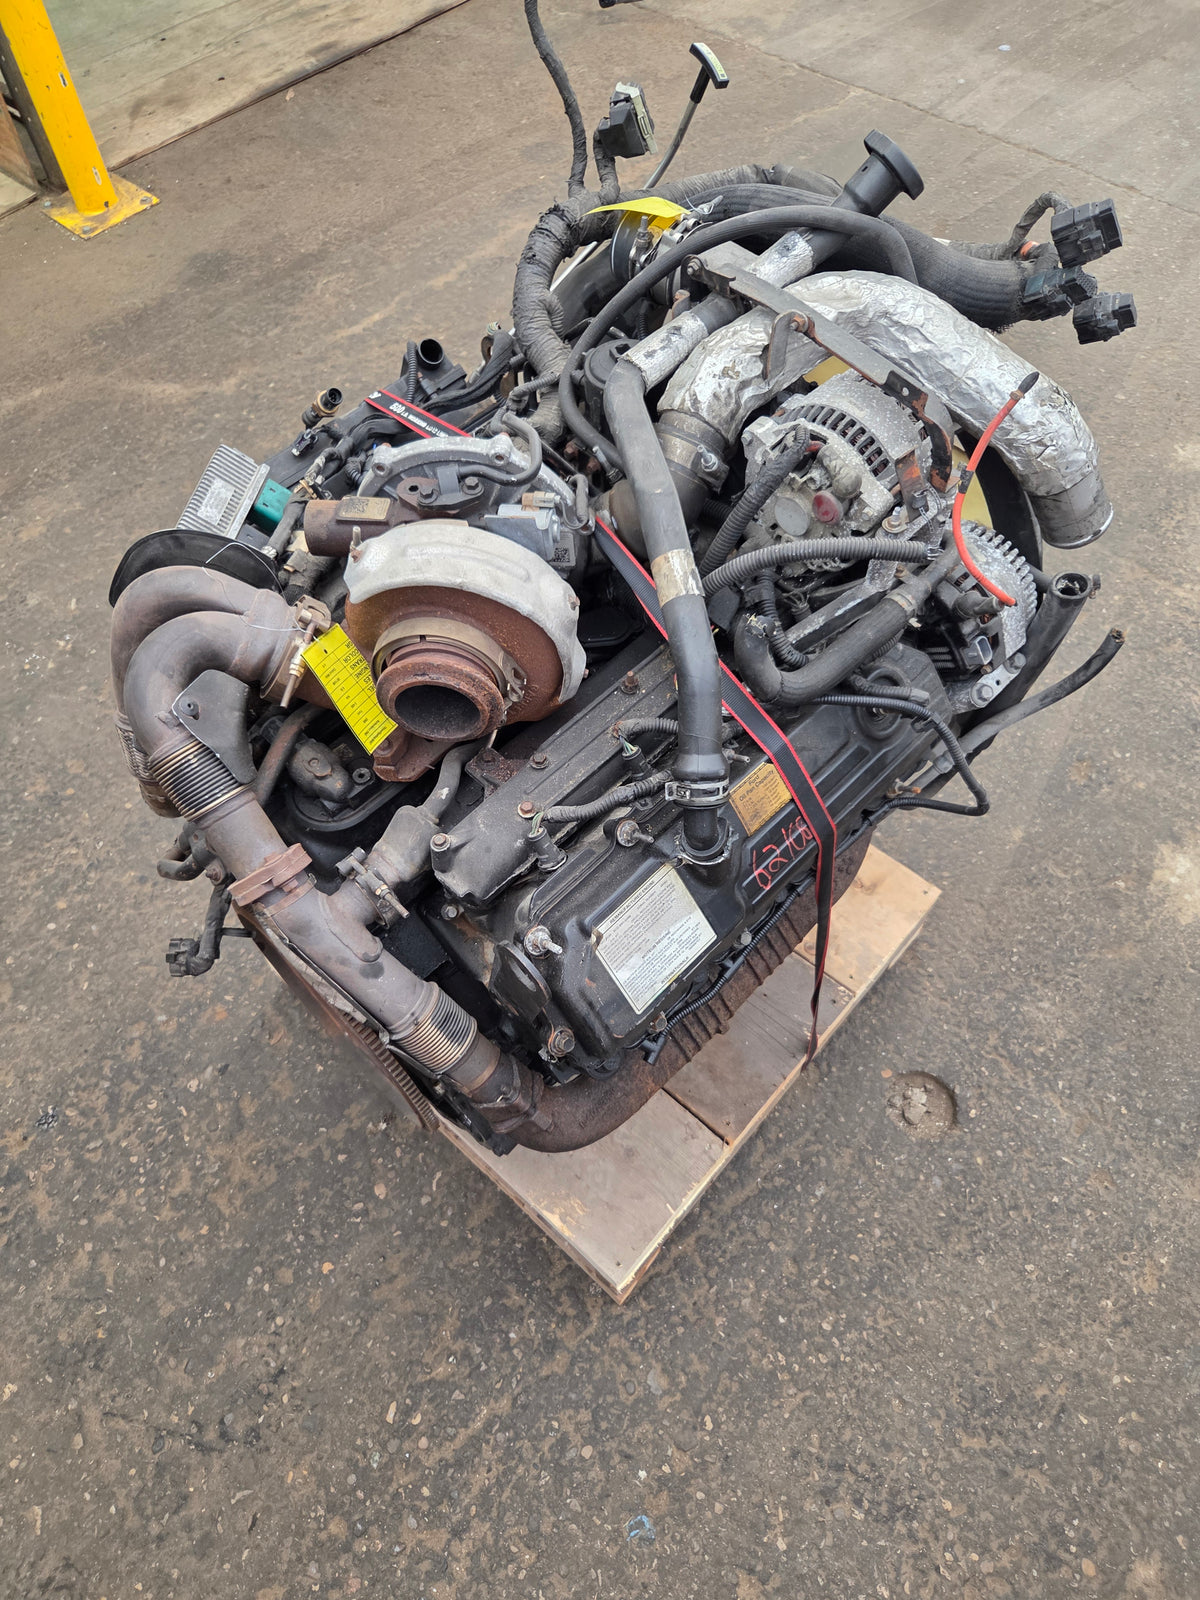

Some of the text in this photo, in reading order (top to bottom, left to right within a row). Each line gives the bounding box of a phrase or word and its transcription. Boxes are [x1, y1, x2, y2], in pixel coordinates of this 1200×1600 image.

[389, 402, 406, 414] 600
[343, 648, 360, 663] COLOR
[350, 656, 365, 671] TRANS
[755, 770, 774, 786] Capacity
